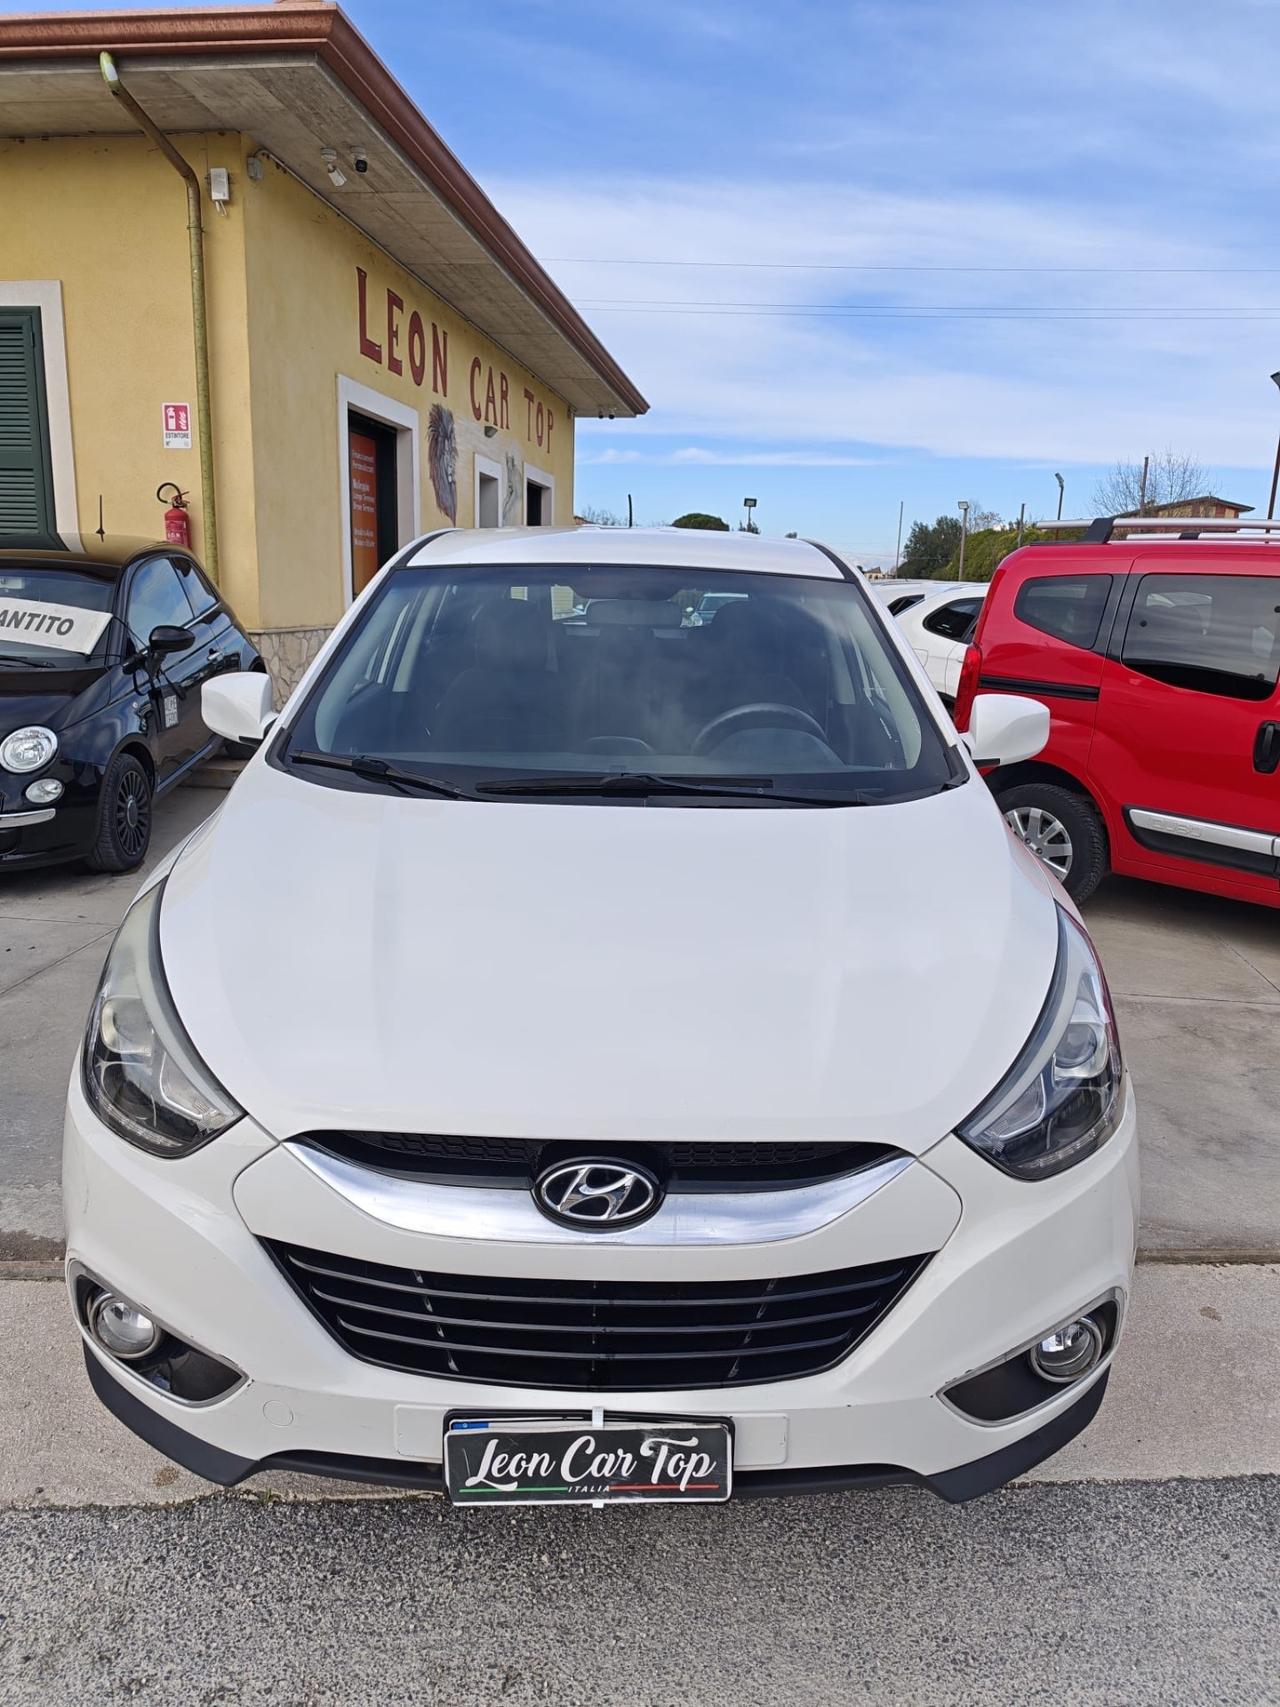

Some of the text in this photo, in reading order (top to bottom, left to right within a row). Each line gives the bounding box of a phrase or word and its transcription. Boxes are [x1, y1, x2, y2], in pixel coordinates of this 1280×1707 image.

[356, 266, 554, 454] LEON CAR TOP
[165, 432, 190, 440] ESTINTORE
[465, 1435, 717, 1492] Leon Car Top
[567, 1486, 611, 1494] ITALIA
